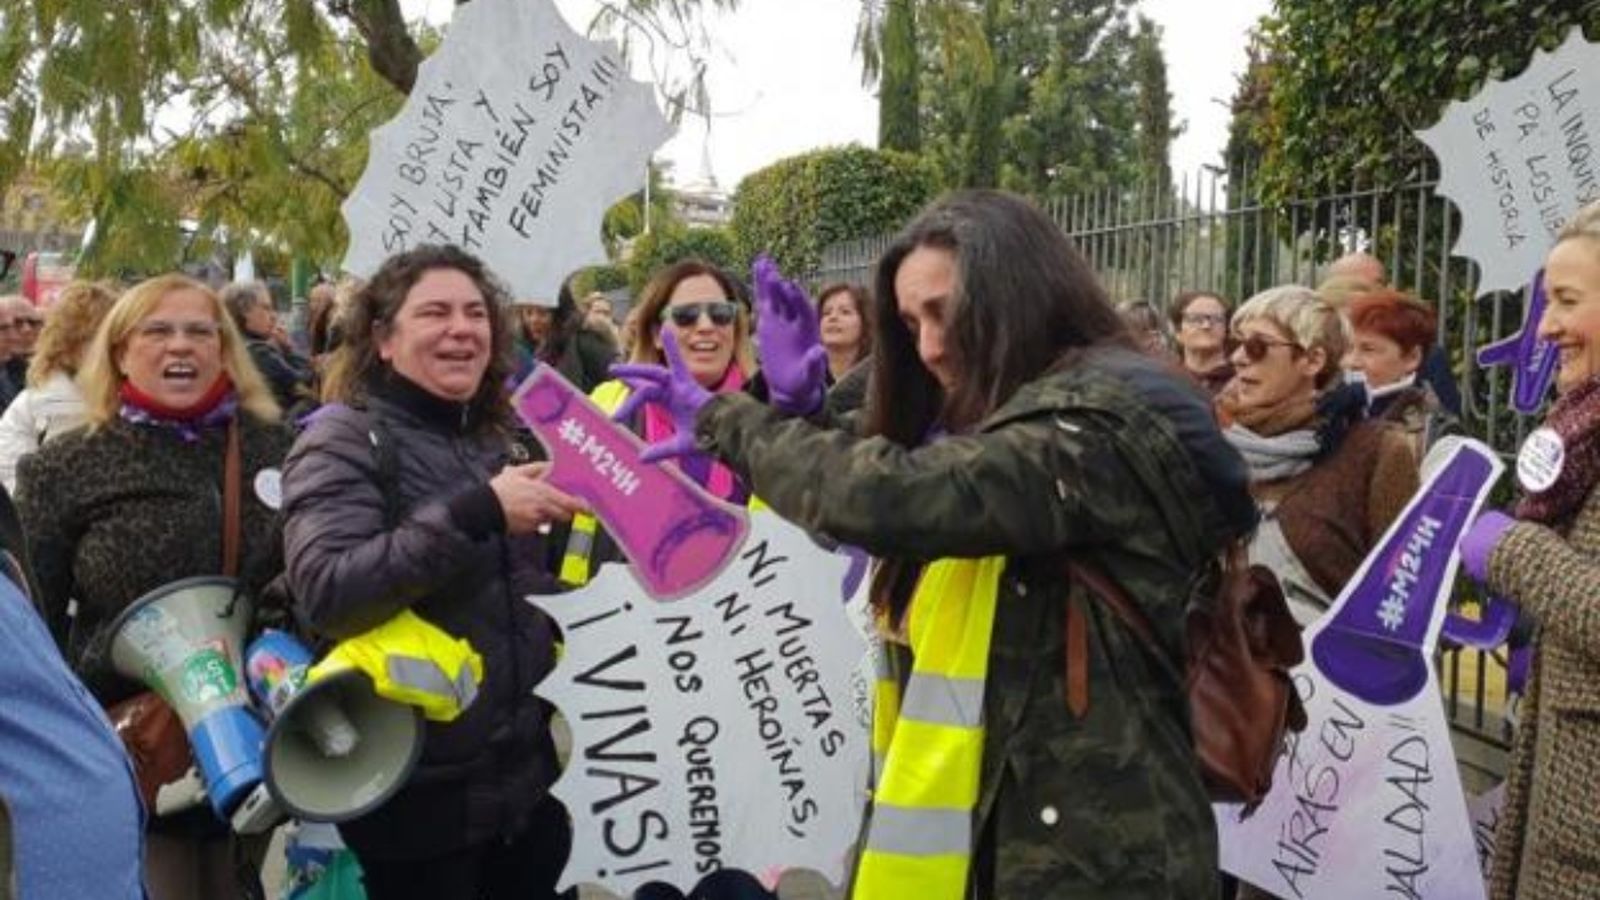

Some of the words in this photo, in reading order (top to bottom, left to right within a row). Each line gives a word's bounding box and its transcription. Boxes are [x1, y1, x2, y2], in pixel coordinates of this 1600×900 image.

[1473, 106, 1497, 142] DE
[1547, 68, 1580, 115] LA
[427, 220, 451, 244] Y
[472, 88, 500, 123] Y
[460, 103, 537, 250] TAMBIÉN
[528, 42, 571, 101] SOY
[381, 192, 418, 256] SOY
[557, 417, 641, 495] #M24H
[1376, 514, 1442, 632] #M24H
[714, 592, 751, 636] NI
[742, 540, 788, 588] NI
[765, 602, 845, 758] MUERTAS
[656, 615, 704, 693] NOS
[1320, 698, 1365, 762] EN
[677, 715, 723, 874] QUEREMOS
